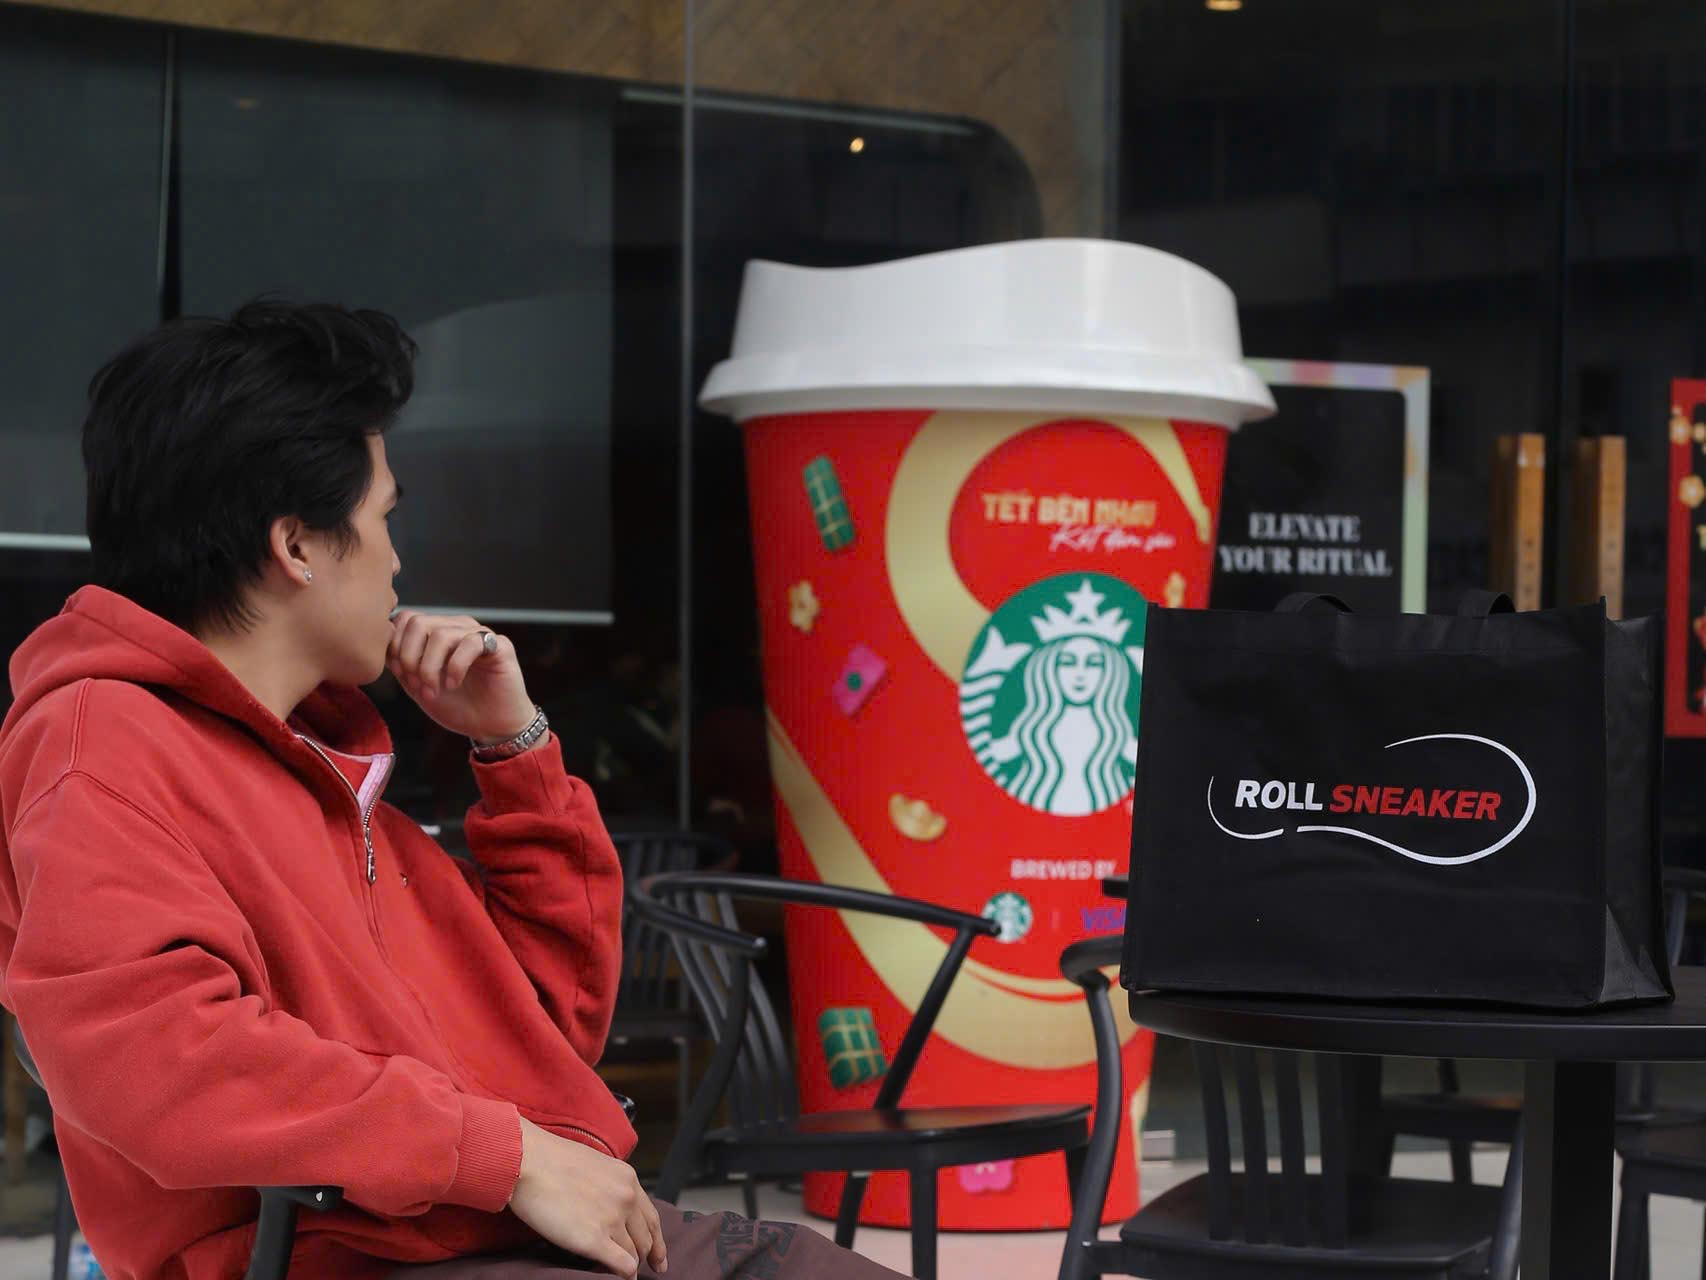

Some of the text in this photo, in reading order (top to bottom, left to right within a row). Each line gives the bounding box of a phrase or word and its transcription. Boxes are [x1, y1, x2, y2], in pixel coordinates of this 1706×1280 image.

[1249, 512, 1361, 543] ELEVATE
[1218, 544, 1393, 577] YOUR RITUAL
[1234, 779, 1502, 822] ROLL SNEAKER
[1010, 858, 1117, 880] BREWED BY
